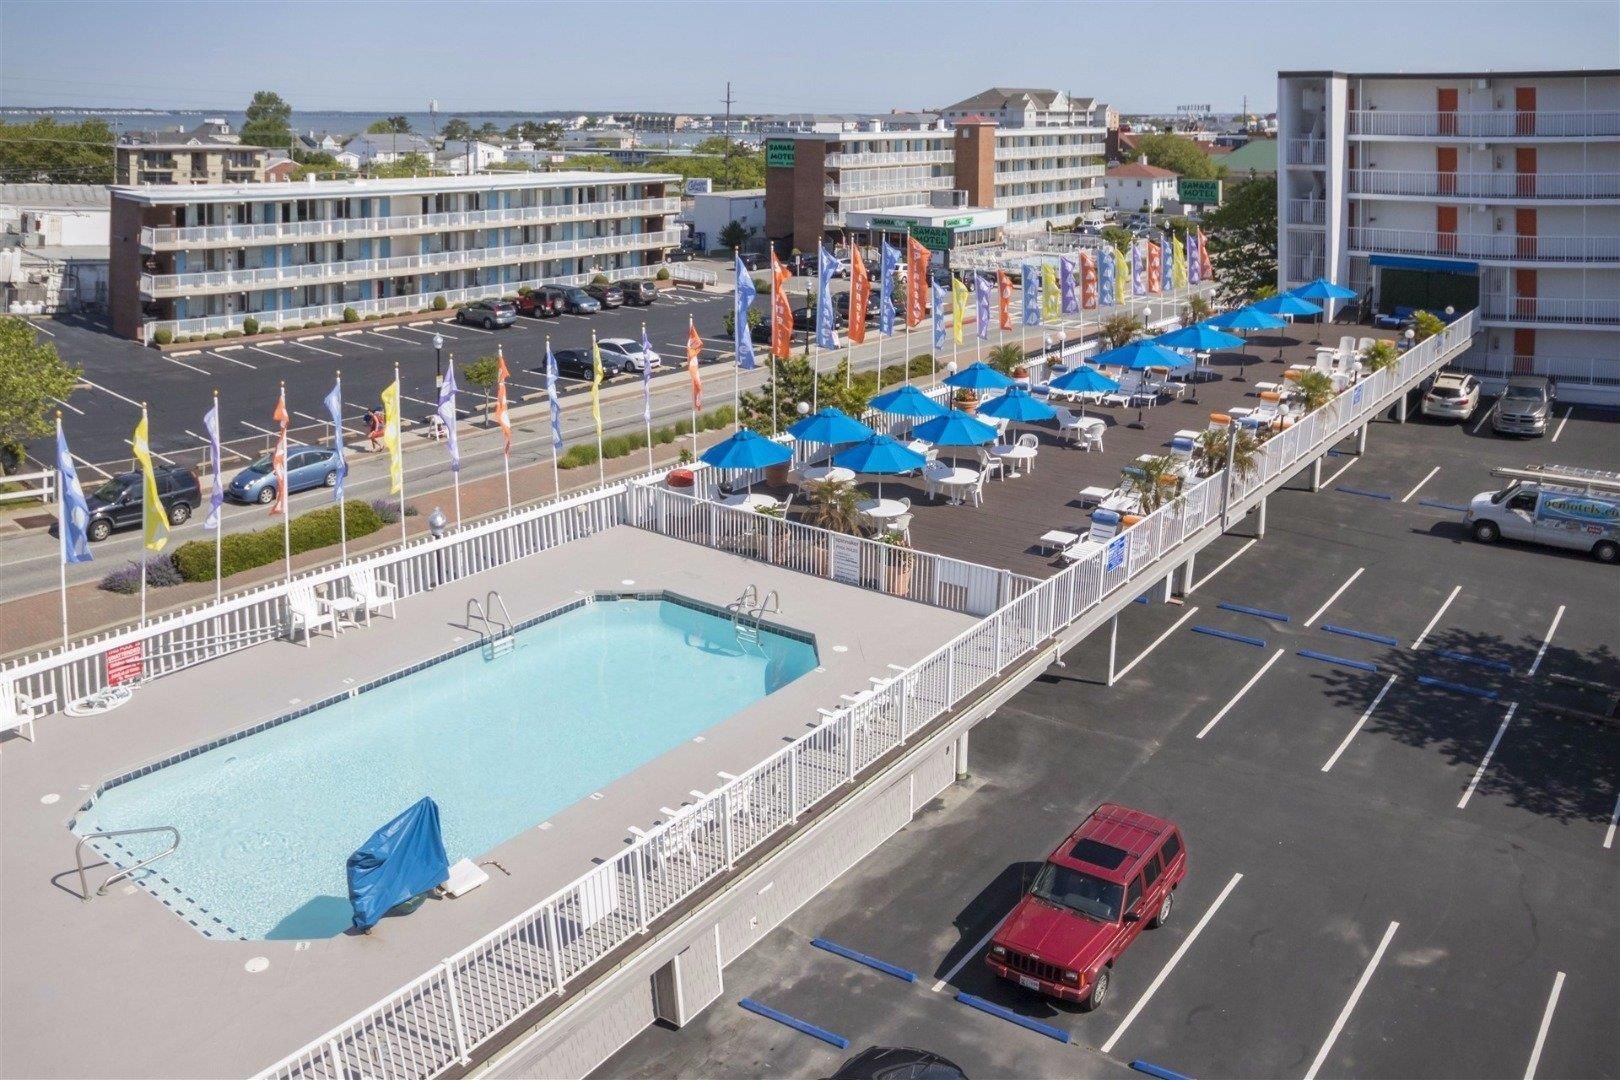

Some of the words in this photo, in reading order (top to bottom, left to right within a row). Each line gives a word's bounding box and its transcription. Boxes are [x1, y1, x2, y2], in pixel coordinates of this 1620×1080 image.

[1181, 181, 1216, 190] SAHARA
[1184, 189, 1216, 197] MOTEL
[913, 227, 947, 237] SAHARA
[916, 236, 946, 245] MOTEL
